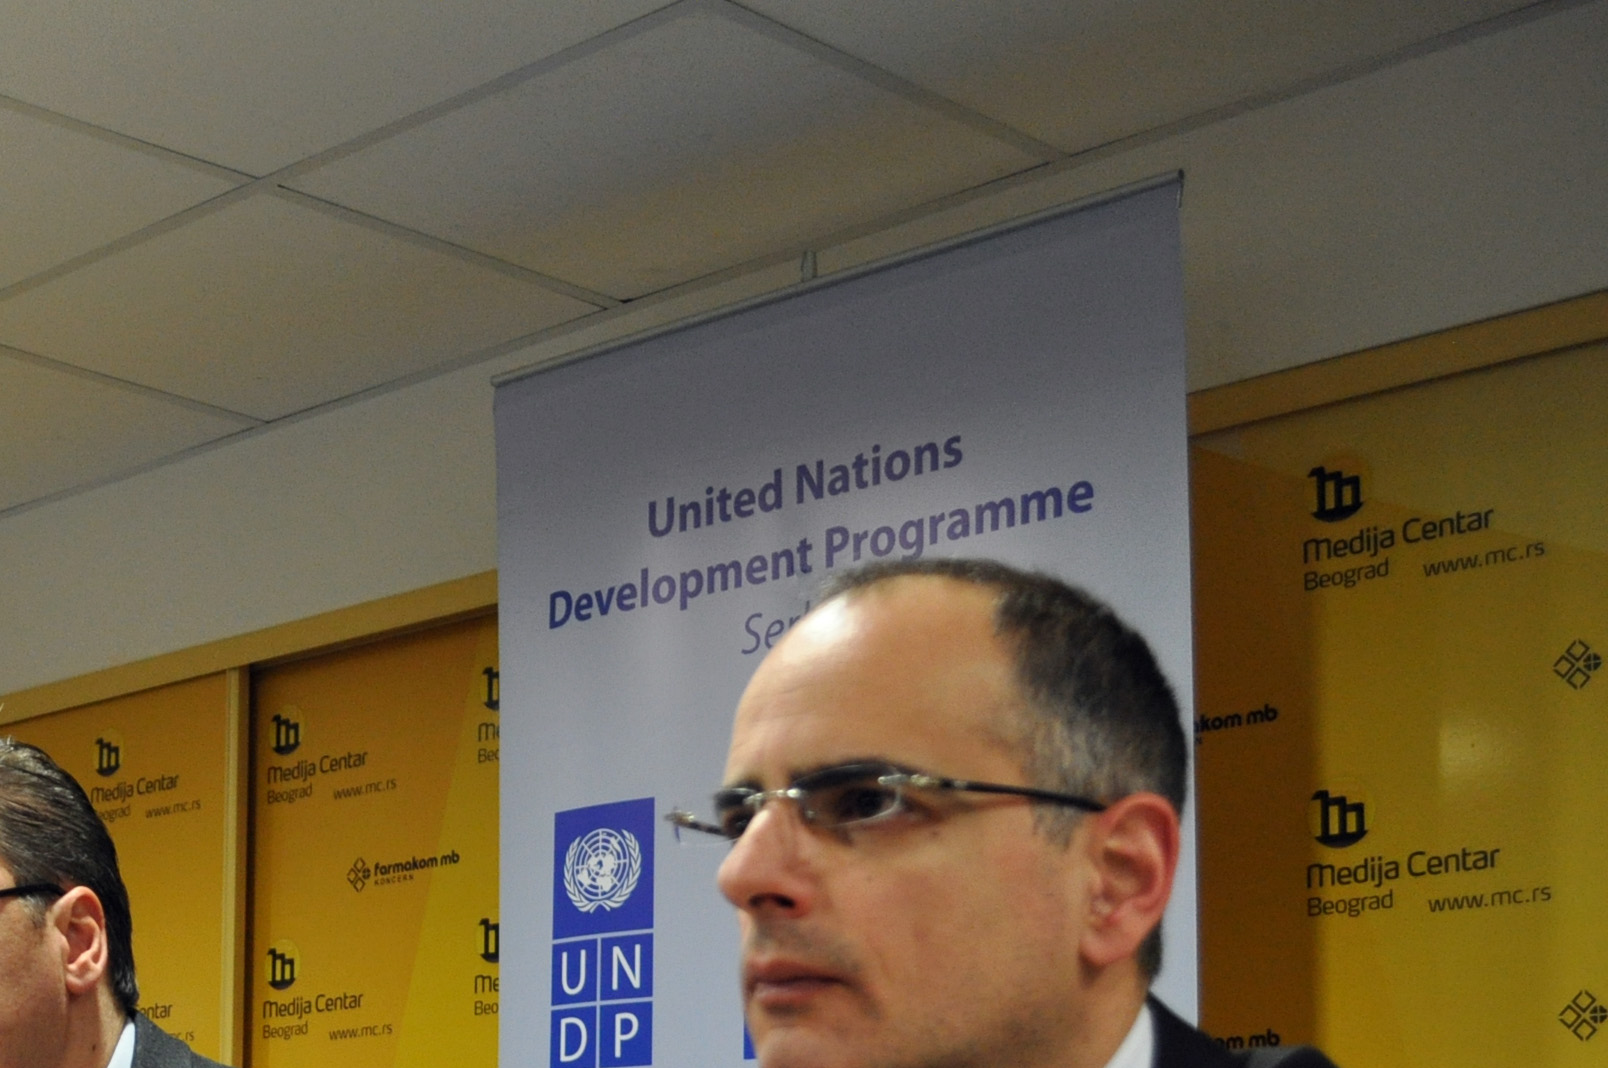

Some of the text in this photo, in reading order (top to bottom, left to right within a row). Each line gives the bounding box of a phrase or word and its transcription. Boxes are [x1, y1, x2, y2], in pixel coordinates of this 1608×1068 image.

[648, 435, 963, 537] United Nations
[1402, 509, 1494, 545] Centar
[548, 480, 1095, 629] Development Programme
[1304, 542, 1546, 591] Beograd www.mc.rs
[741, 600, 810, 655] Ser
[1246, 703, 1278, 725] mb
[319, 751, 368, 774] Centar
[136, 774, 179, 795] Centar
[267, 778, 397, 804] Beograd www.mc.rs
[374, 850, 460, 877] farmakom mb
[1408, 847, 1500, 877] Centar
[1307, 886, 1552, 917] Beograd www.mc.rs
[315, 993, 364, 1012] Centar
[262, 1021, 393, 1041] Beograd www.mc.rs
[1248, 1028, 1280, 1047] mb
